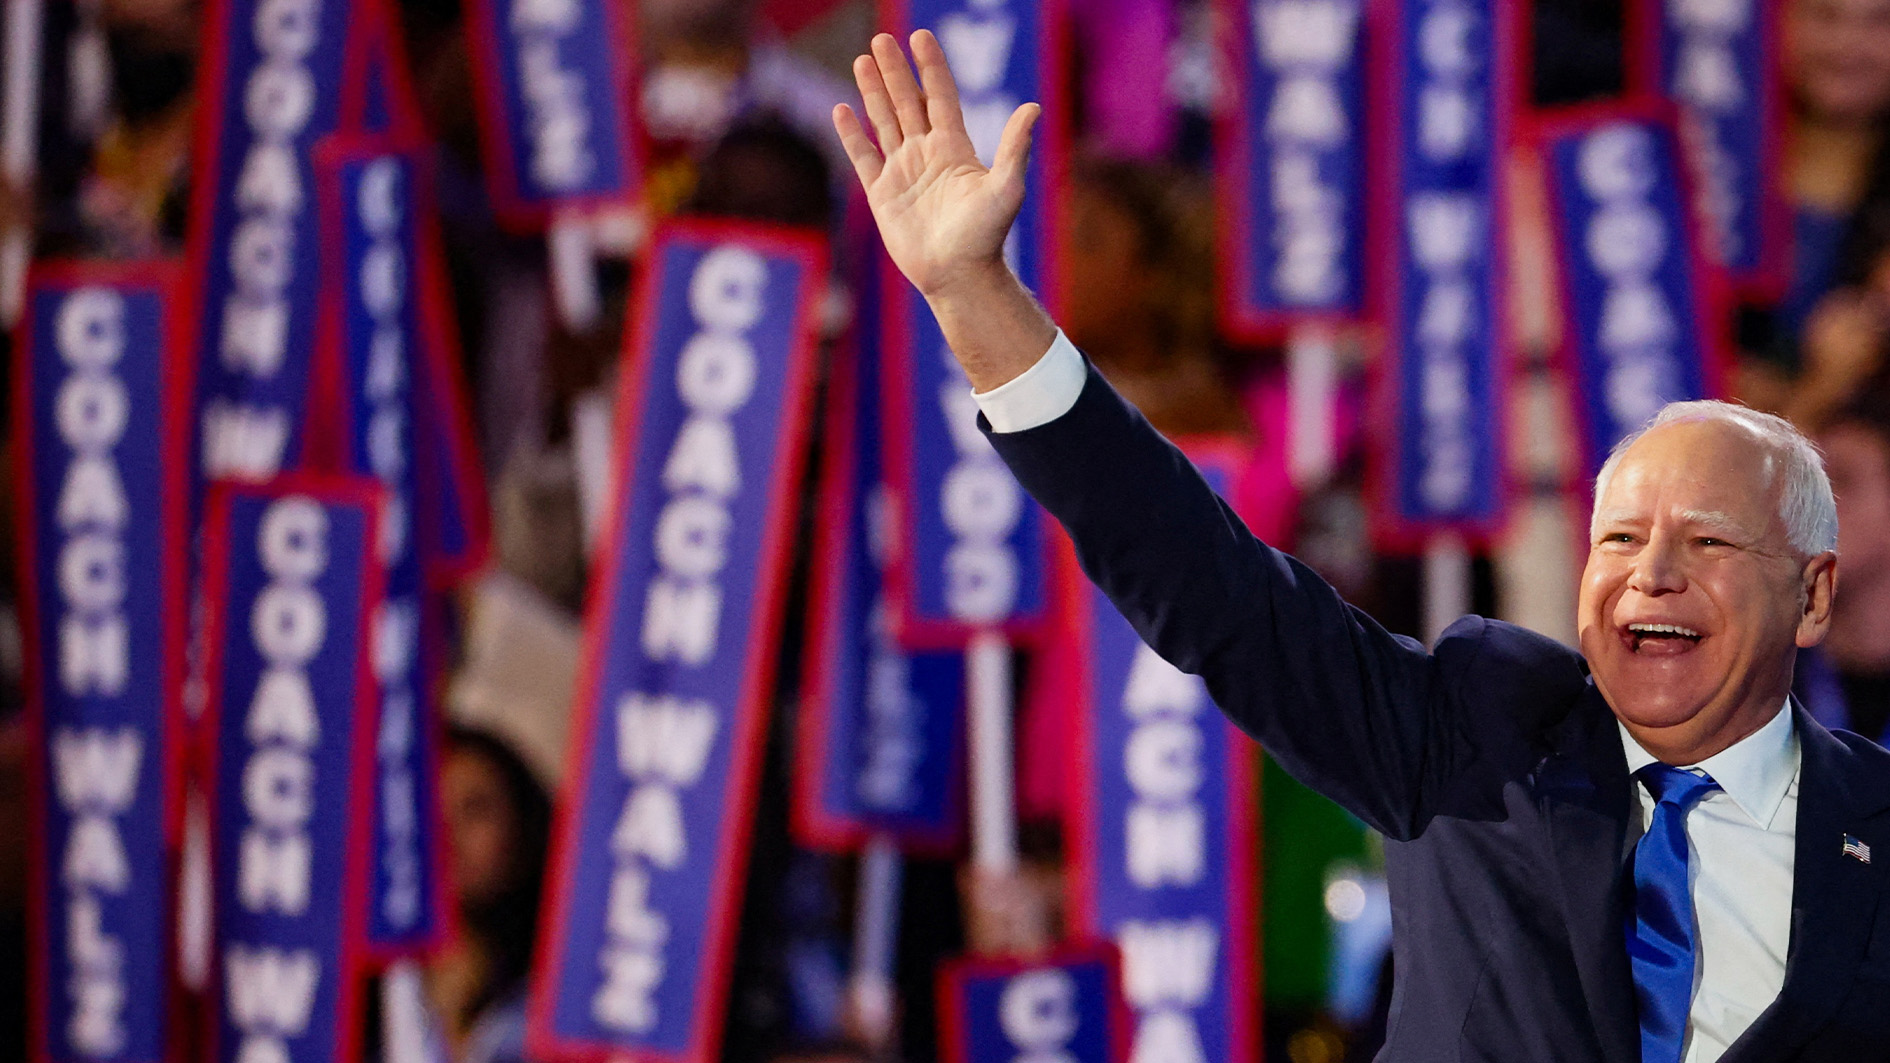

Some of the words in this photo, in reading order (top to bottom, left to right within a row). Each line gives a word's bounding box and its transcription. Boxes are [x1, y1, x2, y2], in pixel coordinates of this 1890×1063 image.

[220, 0, 320, 378] COACH
[1407, 193, 1482, 507] WALZ
[1577, 122, 1684, 440] COAC
[55, 285, 129, 694] COACH
[644, 245, 768, 666] COACH
[241, 496, 329, 915] COACH
[591, 692, 719, 1033] WALZ
[1121, 642, 1206, 888] ACH
[53, 725, 142, 1056] WALZ
